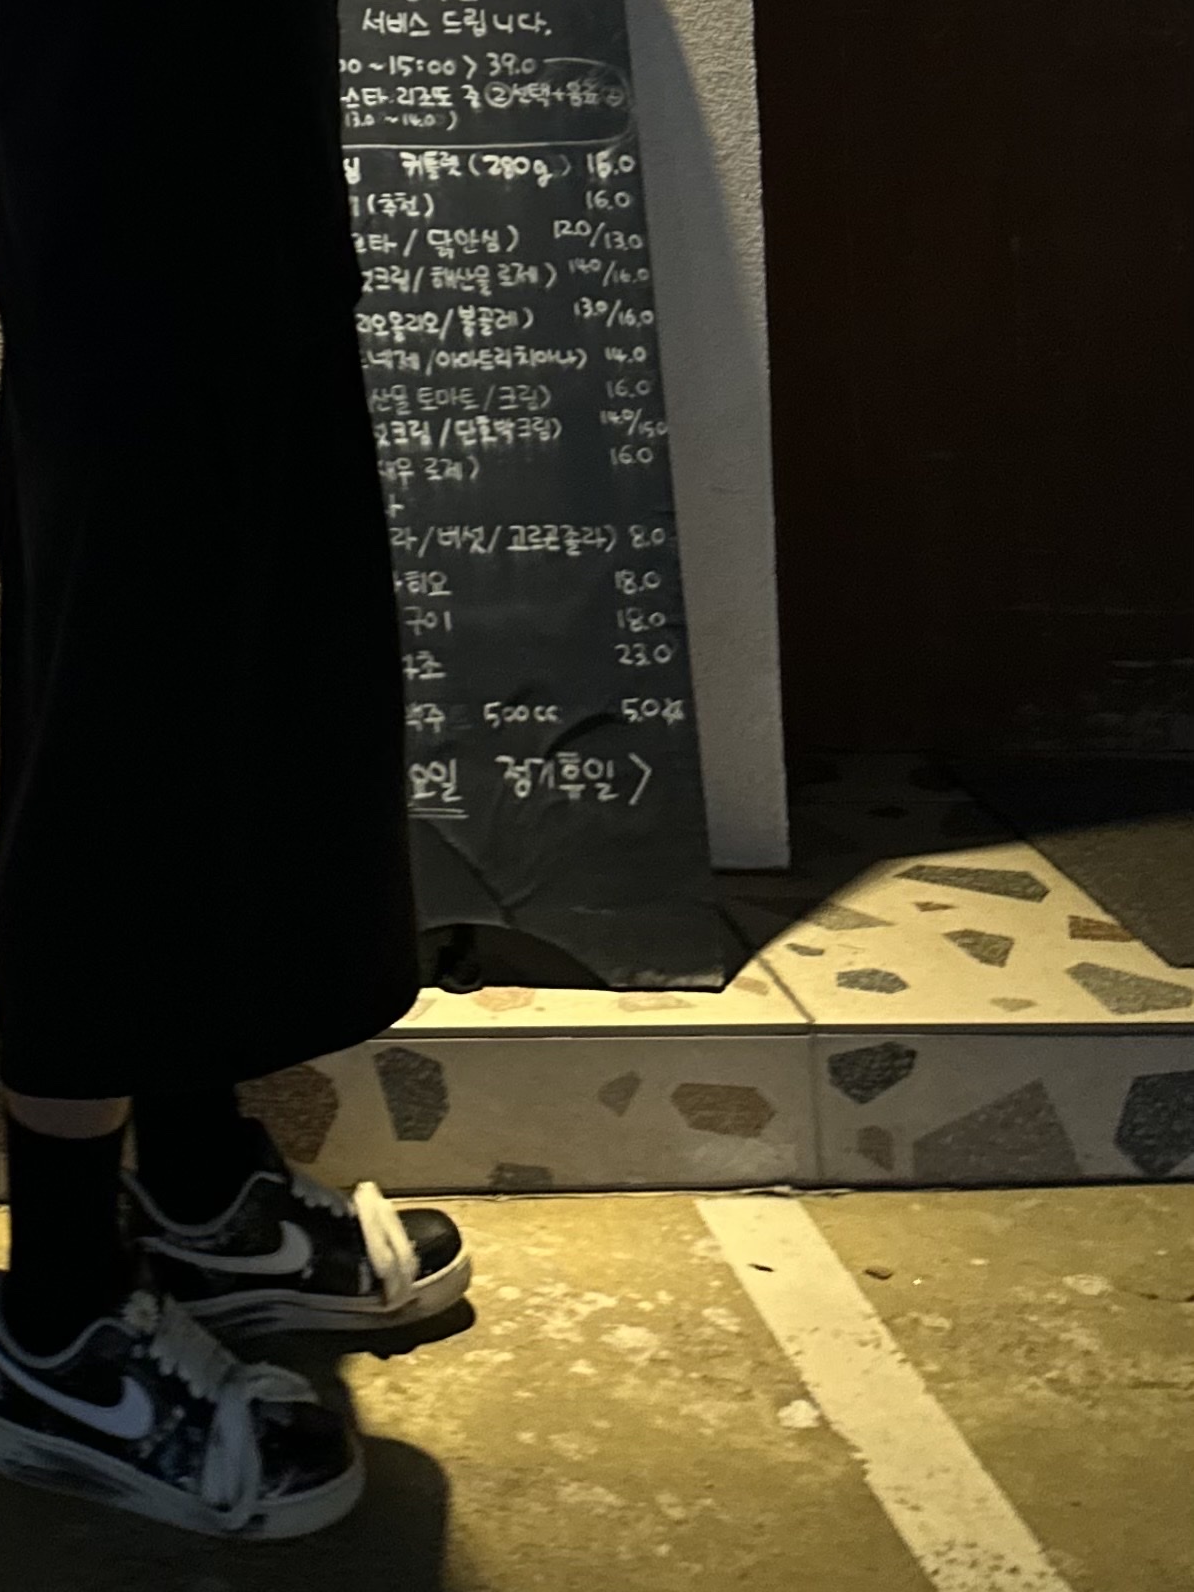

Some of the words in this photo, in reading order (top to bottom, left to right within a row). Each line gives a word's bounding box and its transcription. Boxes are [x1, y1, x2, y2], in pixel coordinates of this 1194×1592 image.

[362, 8, 432, 36] 서비스
[486, 51, 537, 76] 39.0
[367, 192, 435, 218] (추천)
[585, 189, 631, 210] 16.0
[606, 378, 651, 399] 16.0
[629, 523, 666, 549] 8.0
[614, 568, 662, 595] 18.0
[617, 606, 666, 633] 18.0
